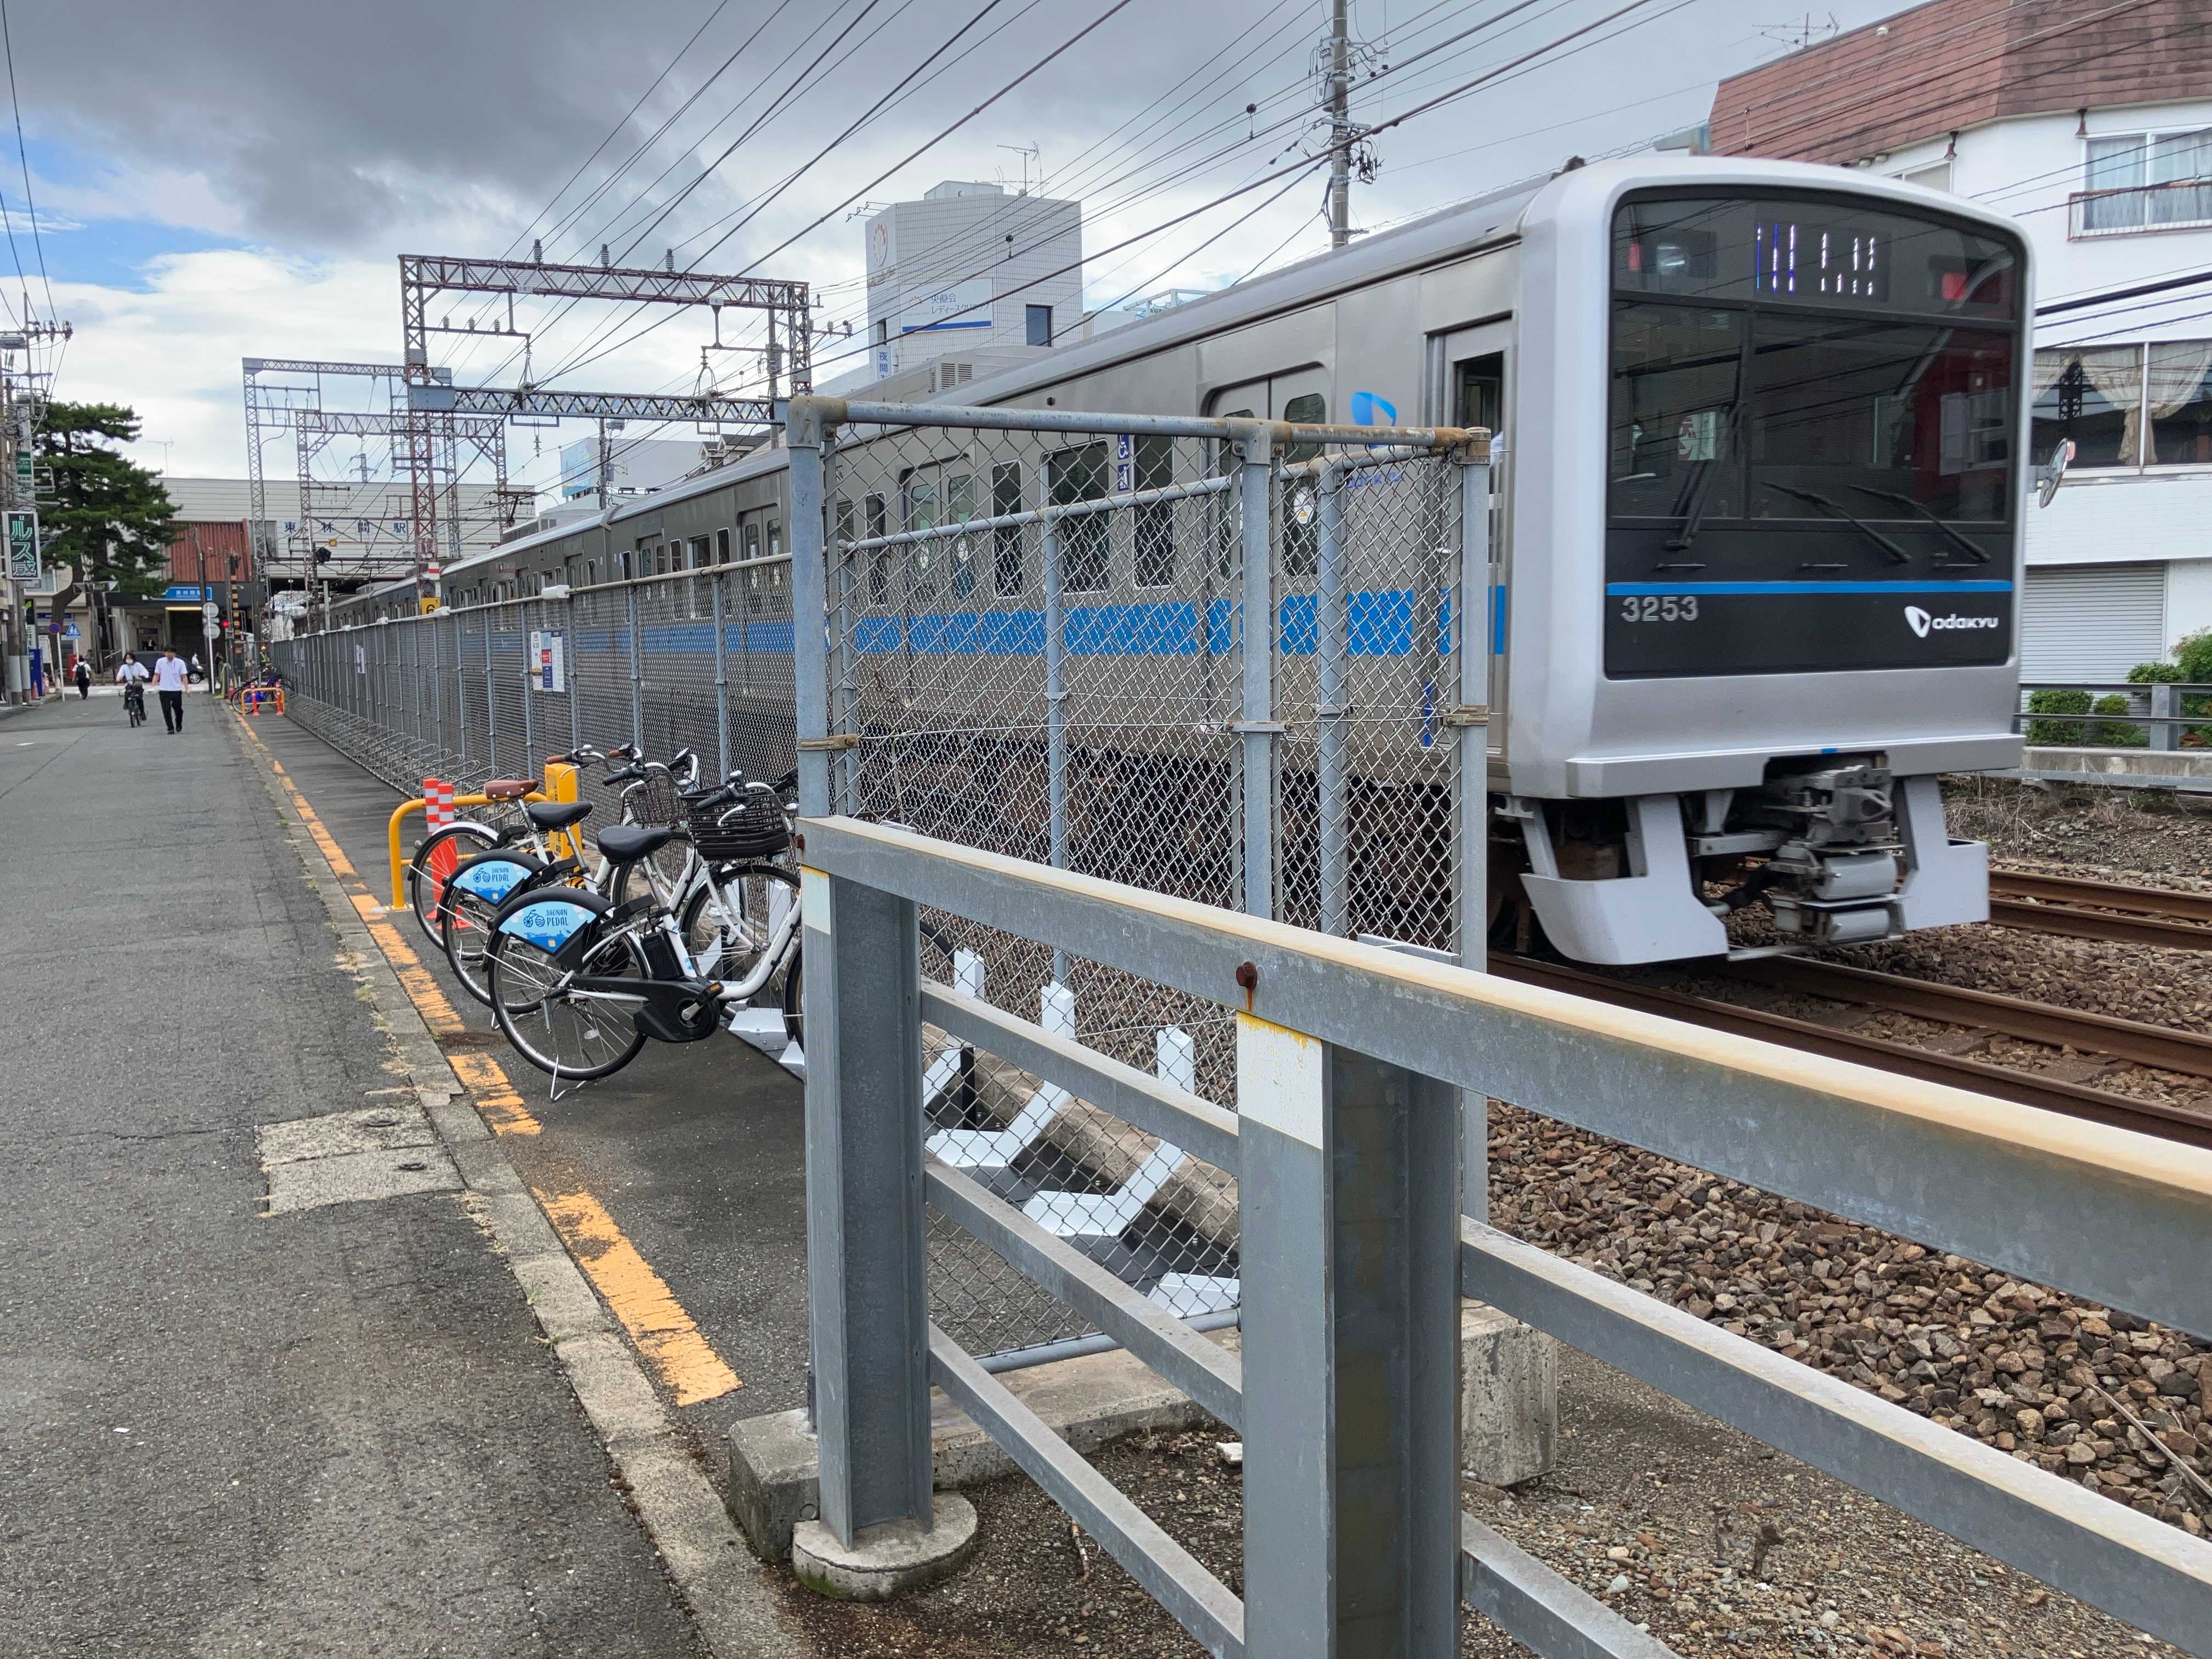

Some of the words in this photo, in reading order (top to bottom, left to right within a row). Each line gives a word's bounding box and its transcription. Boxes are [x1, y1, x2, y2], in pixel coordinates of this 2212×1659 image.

[1621, 596, 1699, 622] 3253
[1932, 608, 1999, 629] odakyu
[547, 917, 568, 926] PEDAL
